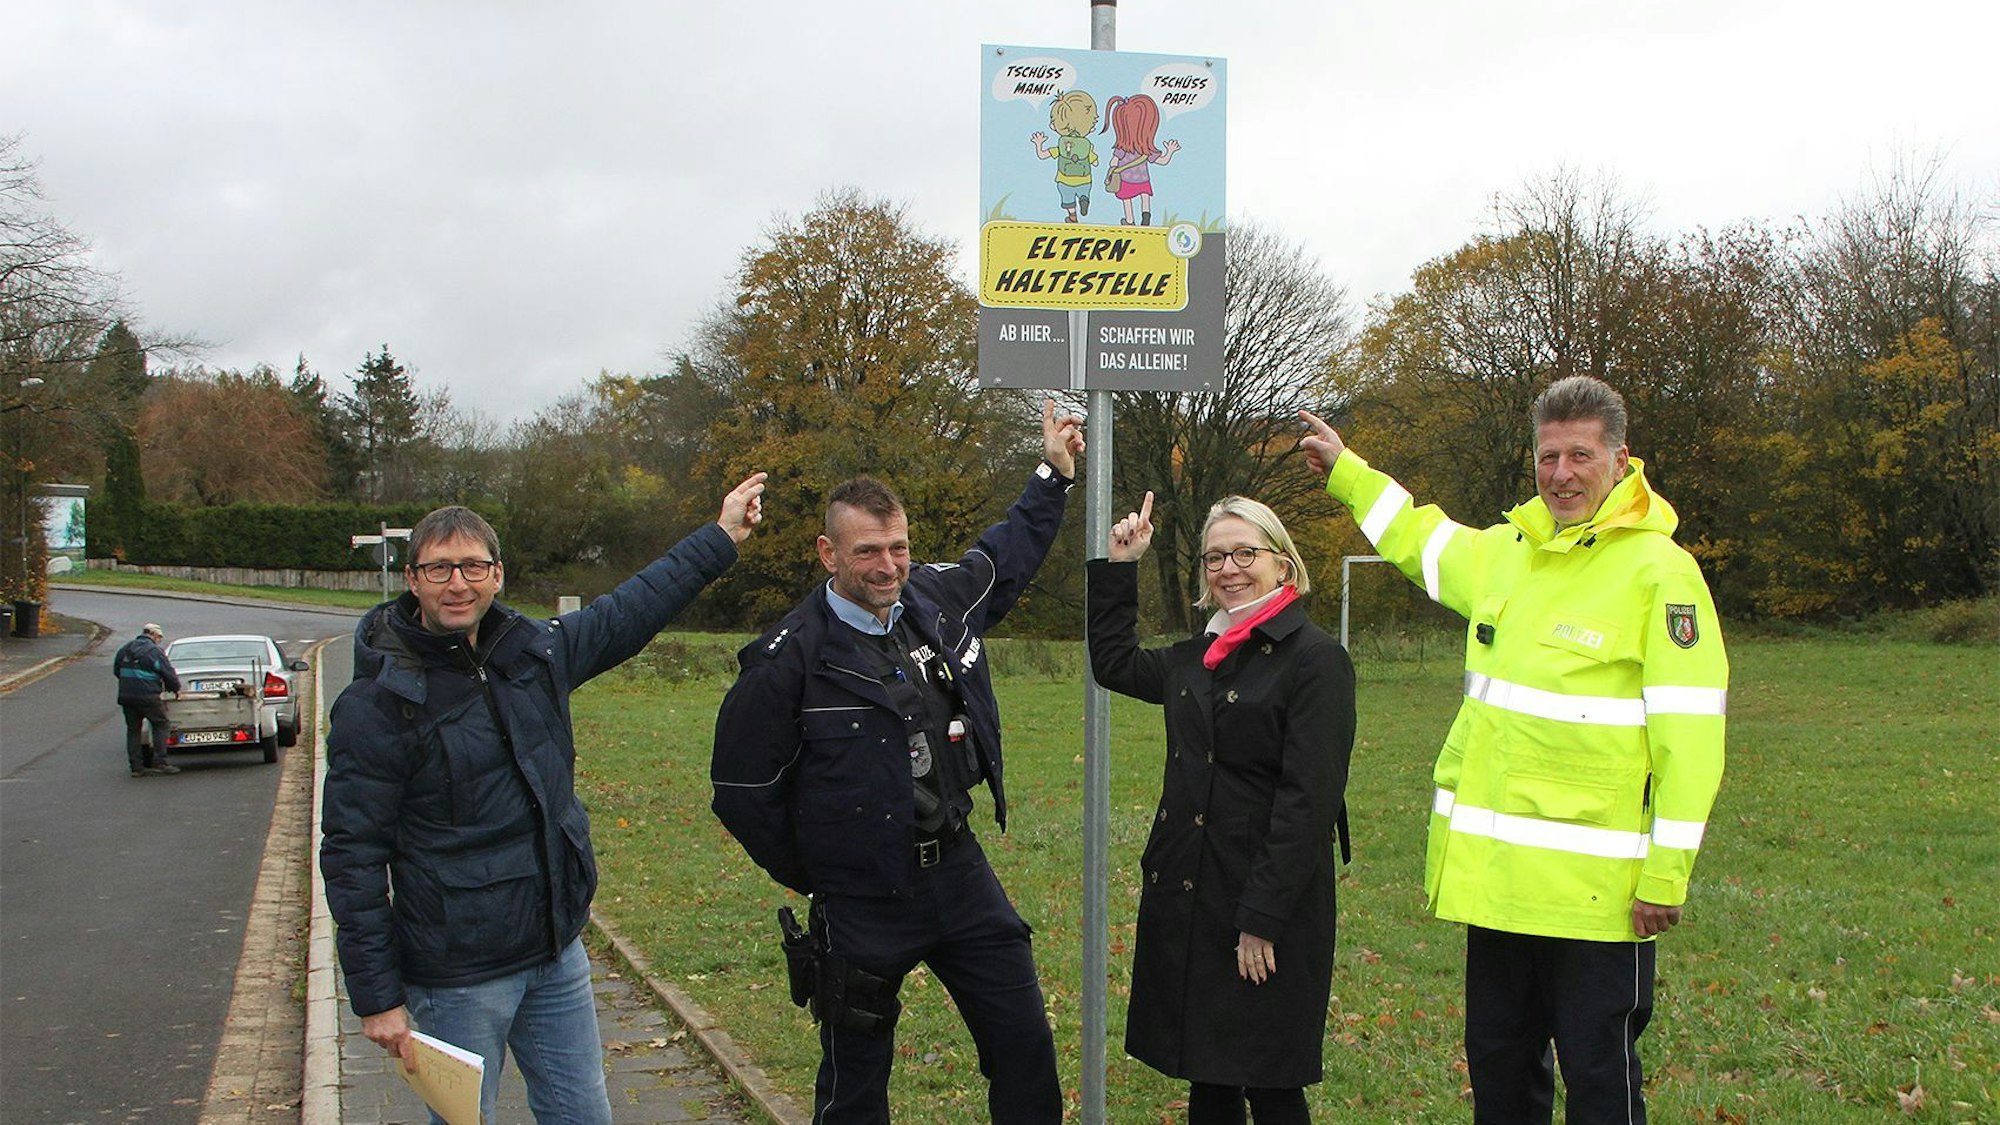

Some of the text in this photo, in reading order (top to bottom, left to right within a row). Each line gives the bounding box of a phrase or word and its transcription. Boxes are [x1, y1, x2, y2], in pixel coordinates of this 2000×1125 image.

[1006, 65, 1064, 79] TSCHÜSS
[1013, 82, 1055, 95] MAMI!
[1153, 75, 1208, 90] TSCHÜSS
[1162, 92, 1197, 105] PAPI!
[1026, 235, 1136, 262] ELTERN-
[995, 268, 1172, 297] HALTESTELLE
[999, 324, 1064, 342] AB HIER...
[1100, 326, 1195, 346] SCHAFFEN WIR
[1100, 352, 1188, 371] DAS ALLEINE!
[1669, 606, 1693, 615] POLIZEI
[1552, 623, 1604, 649] POLIZEI
